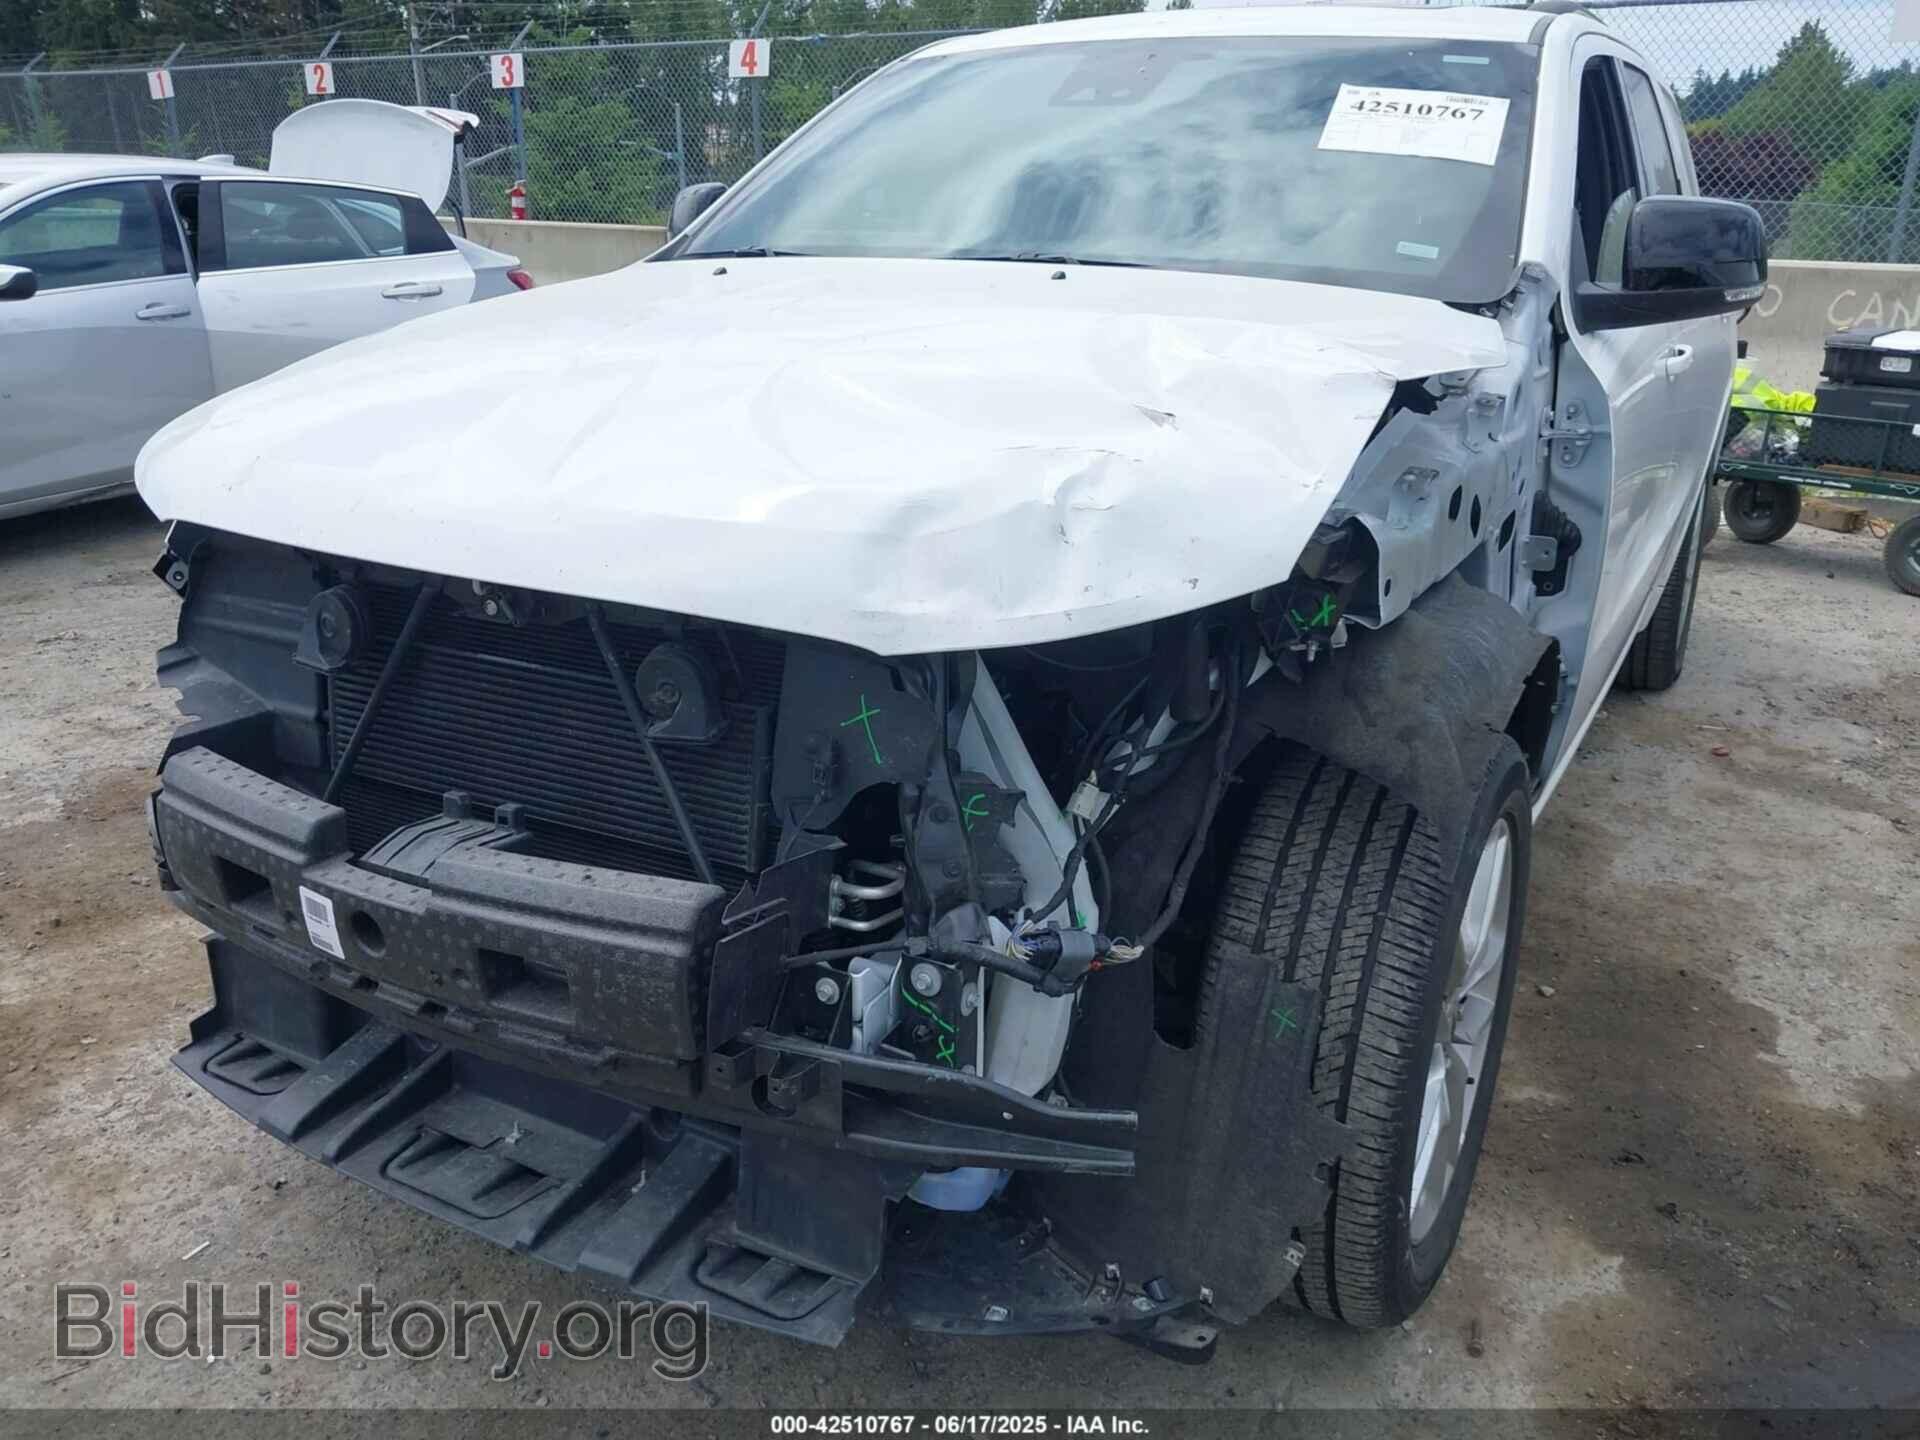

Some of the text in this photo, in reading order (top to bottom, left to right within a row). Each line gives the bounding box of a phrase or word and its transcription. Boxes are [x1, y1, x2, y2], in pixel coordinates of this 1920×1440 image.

[500, 55, 515, 87] 3
[740, 40, 758, 75] 4
[156, 71, 166, 97] 1
[313, 64, 327, 93] 2
[1350, 99, 1486, 121] 42510767
